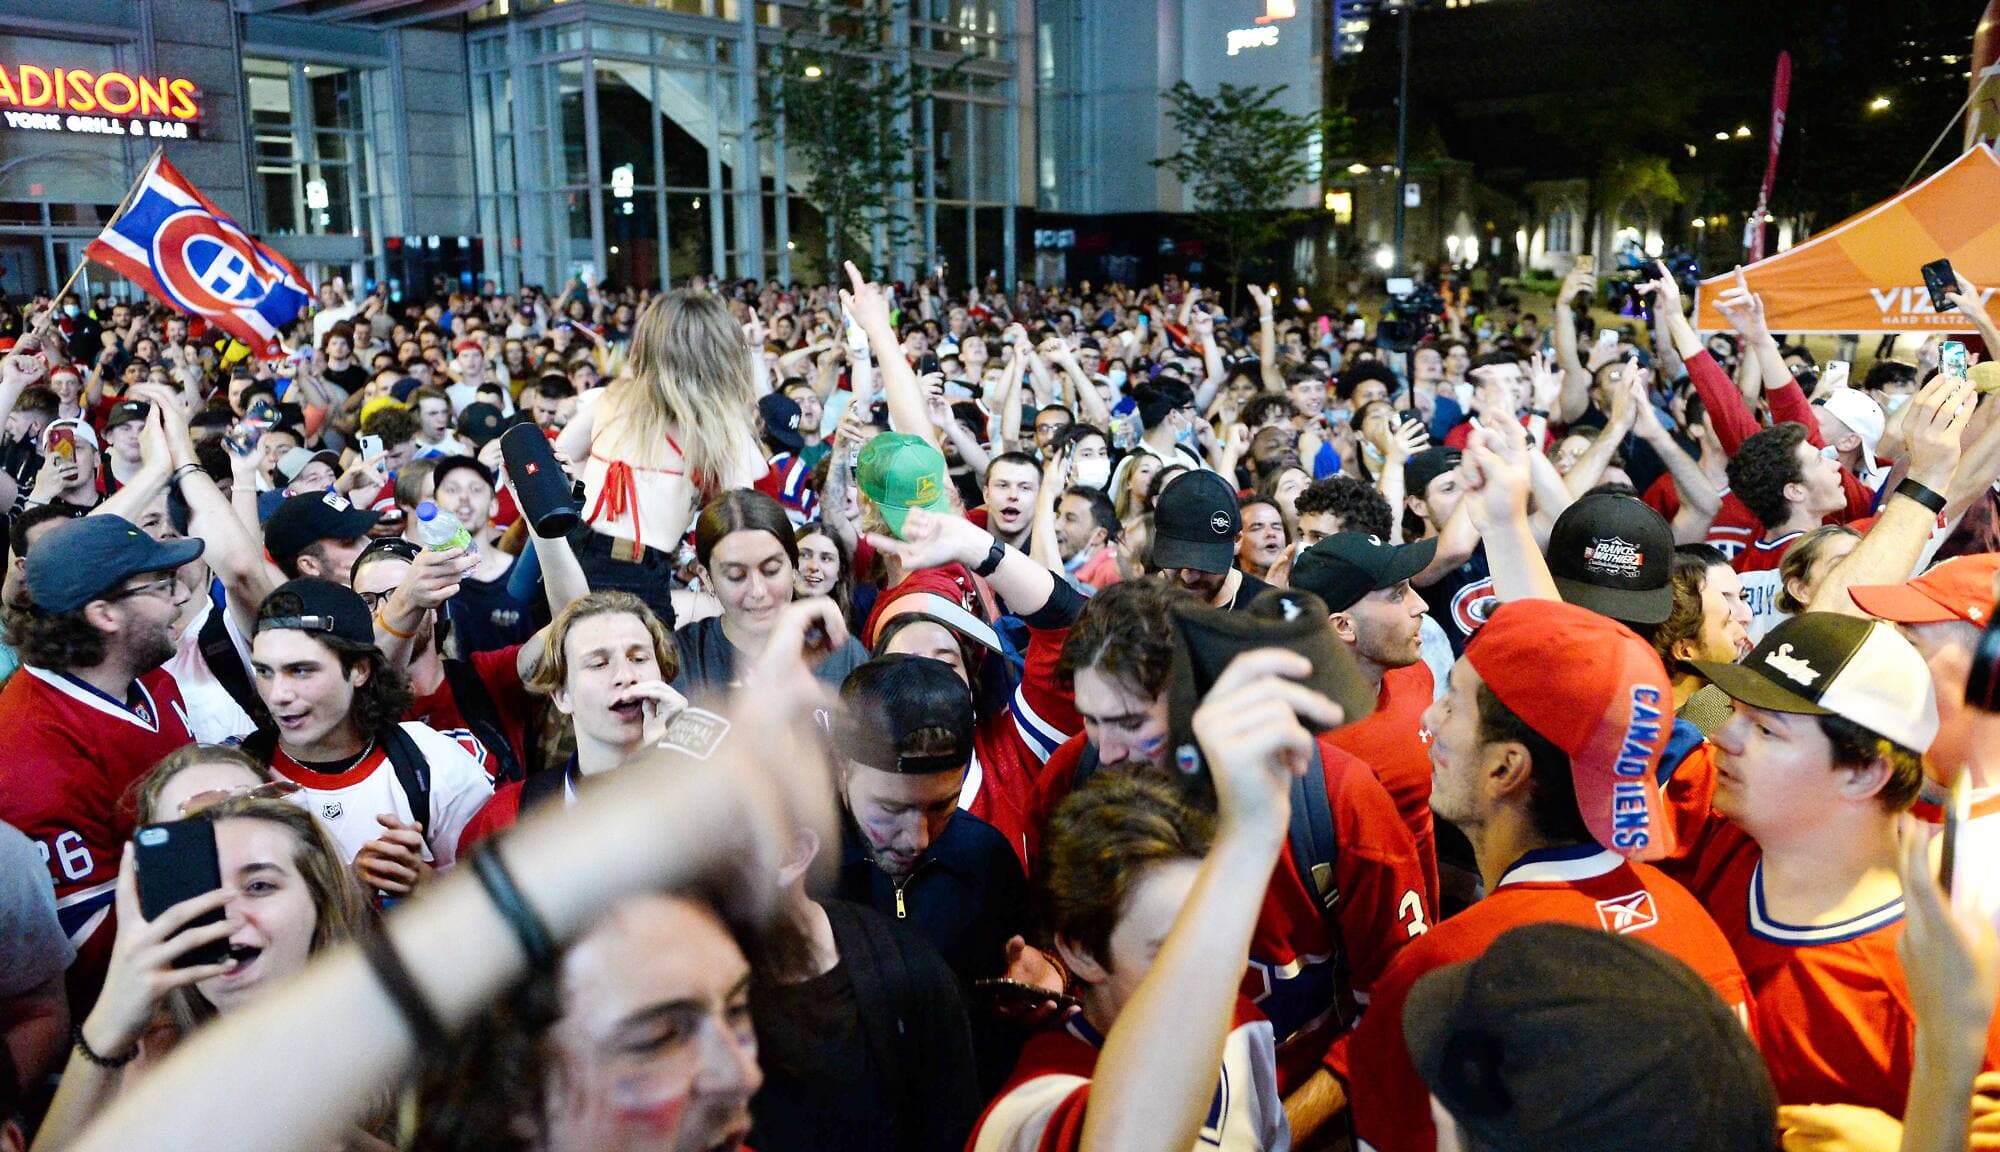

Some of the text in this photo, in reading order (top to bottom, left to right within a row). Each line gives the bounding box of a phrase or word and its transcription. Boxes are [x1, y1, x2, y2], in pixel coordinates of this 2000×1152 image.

[4, 111, 62, 131] YORK
[66, 115, 125, 135] GRILL
[149, 120, 188, 139] BAR
[1870, 286, 1997, 314] VIZ
[1882, 315, 1971, 325] HARD SELTZ
[1595, 543, 1636, 556] FRANCIS
[1612, 683, 1661, 850] CANADIENS
